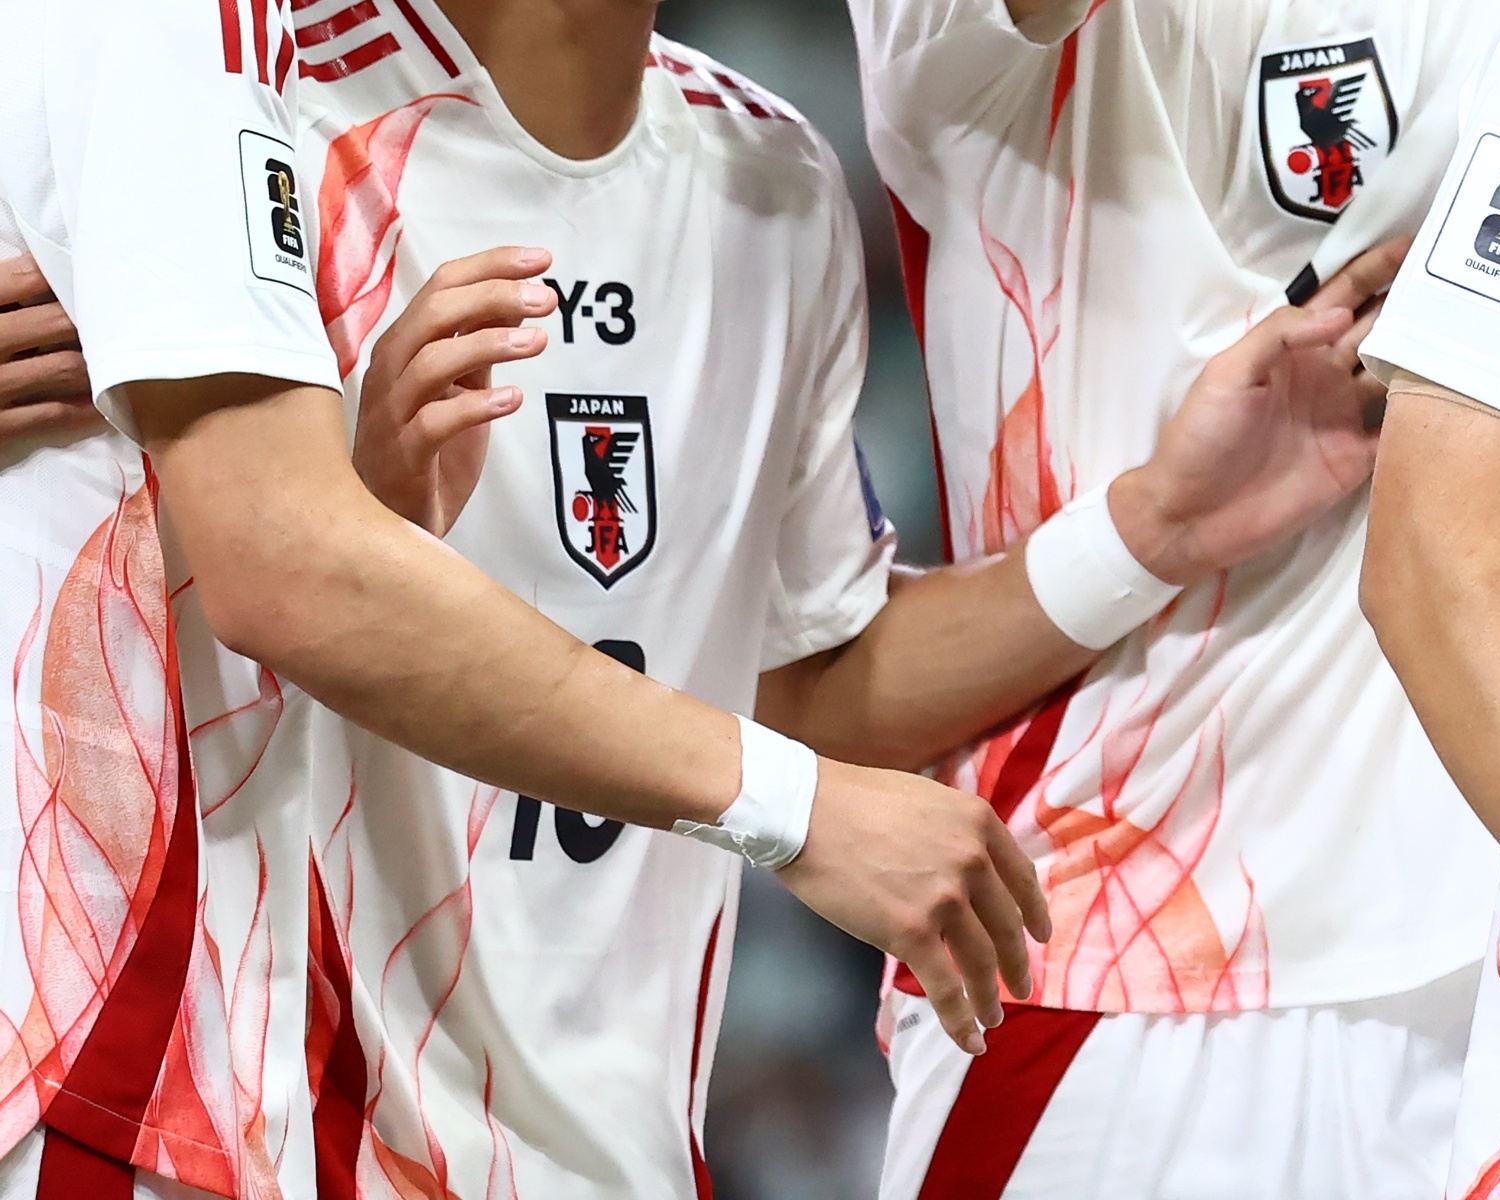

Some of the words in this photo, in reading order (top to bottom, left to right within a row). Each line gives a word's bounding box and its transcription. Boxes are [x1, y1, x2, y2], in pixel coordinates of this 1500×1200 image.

[1280, 48, 1345, 72] JAPAN
[1308, 166, 1364, 202] JFA
[282, 233, 299, 250] FIFA
[542, 278, 636, 346] Y-3
[569, 398, 625, 416] JAPAN
[585, 526, 630, 555] JFA
